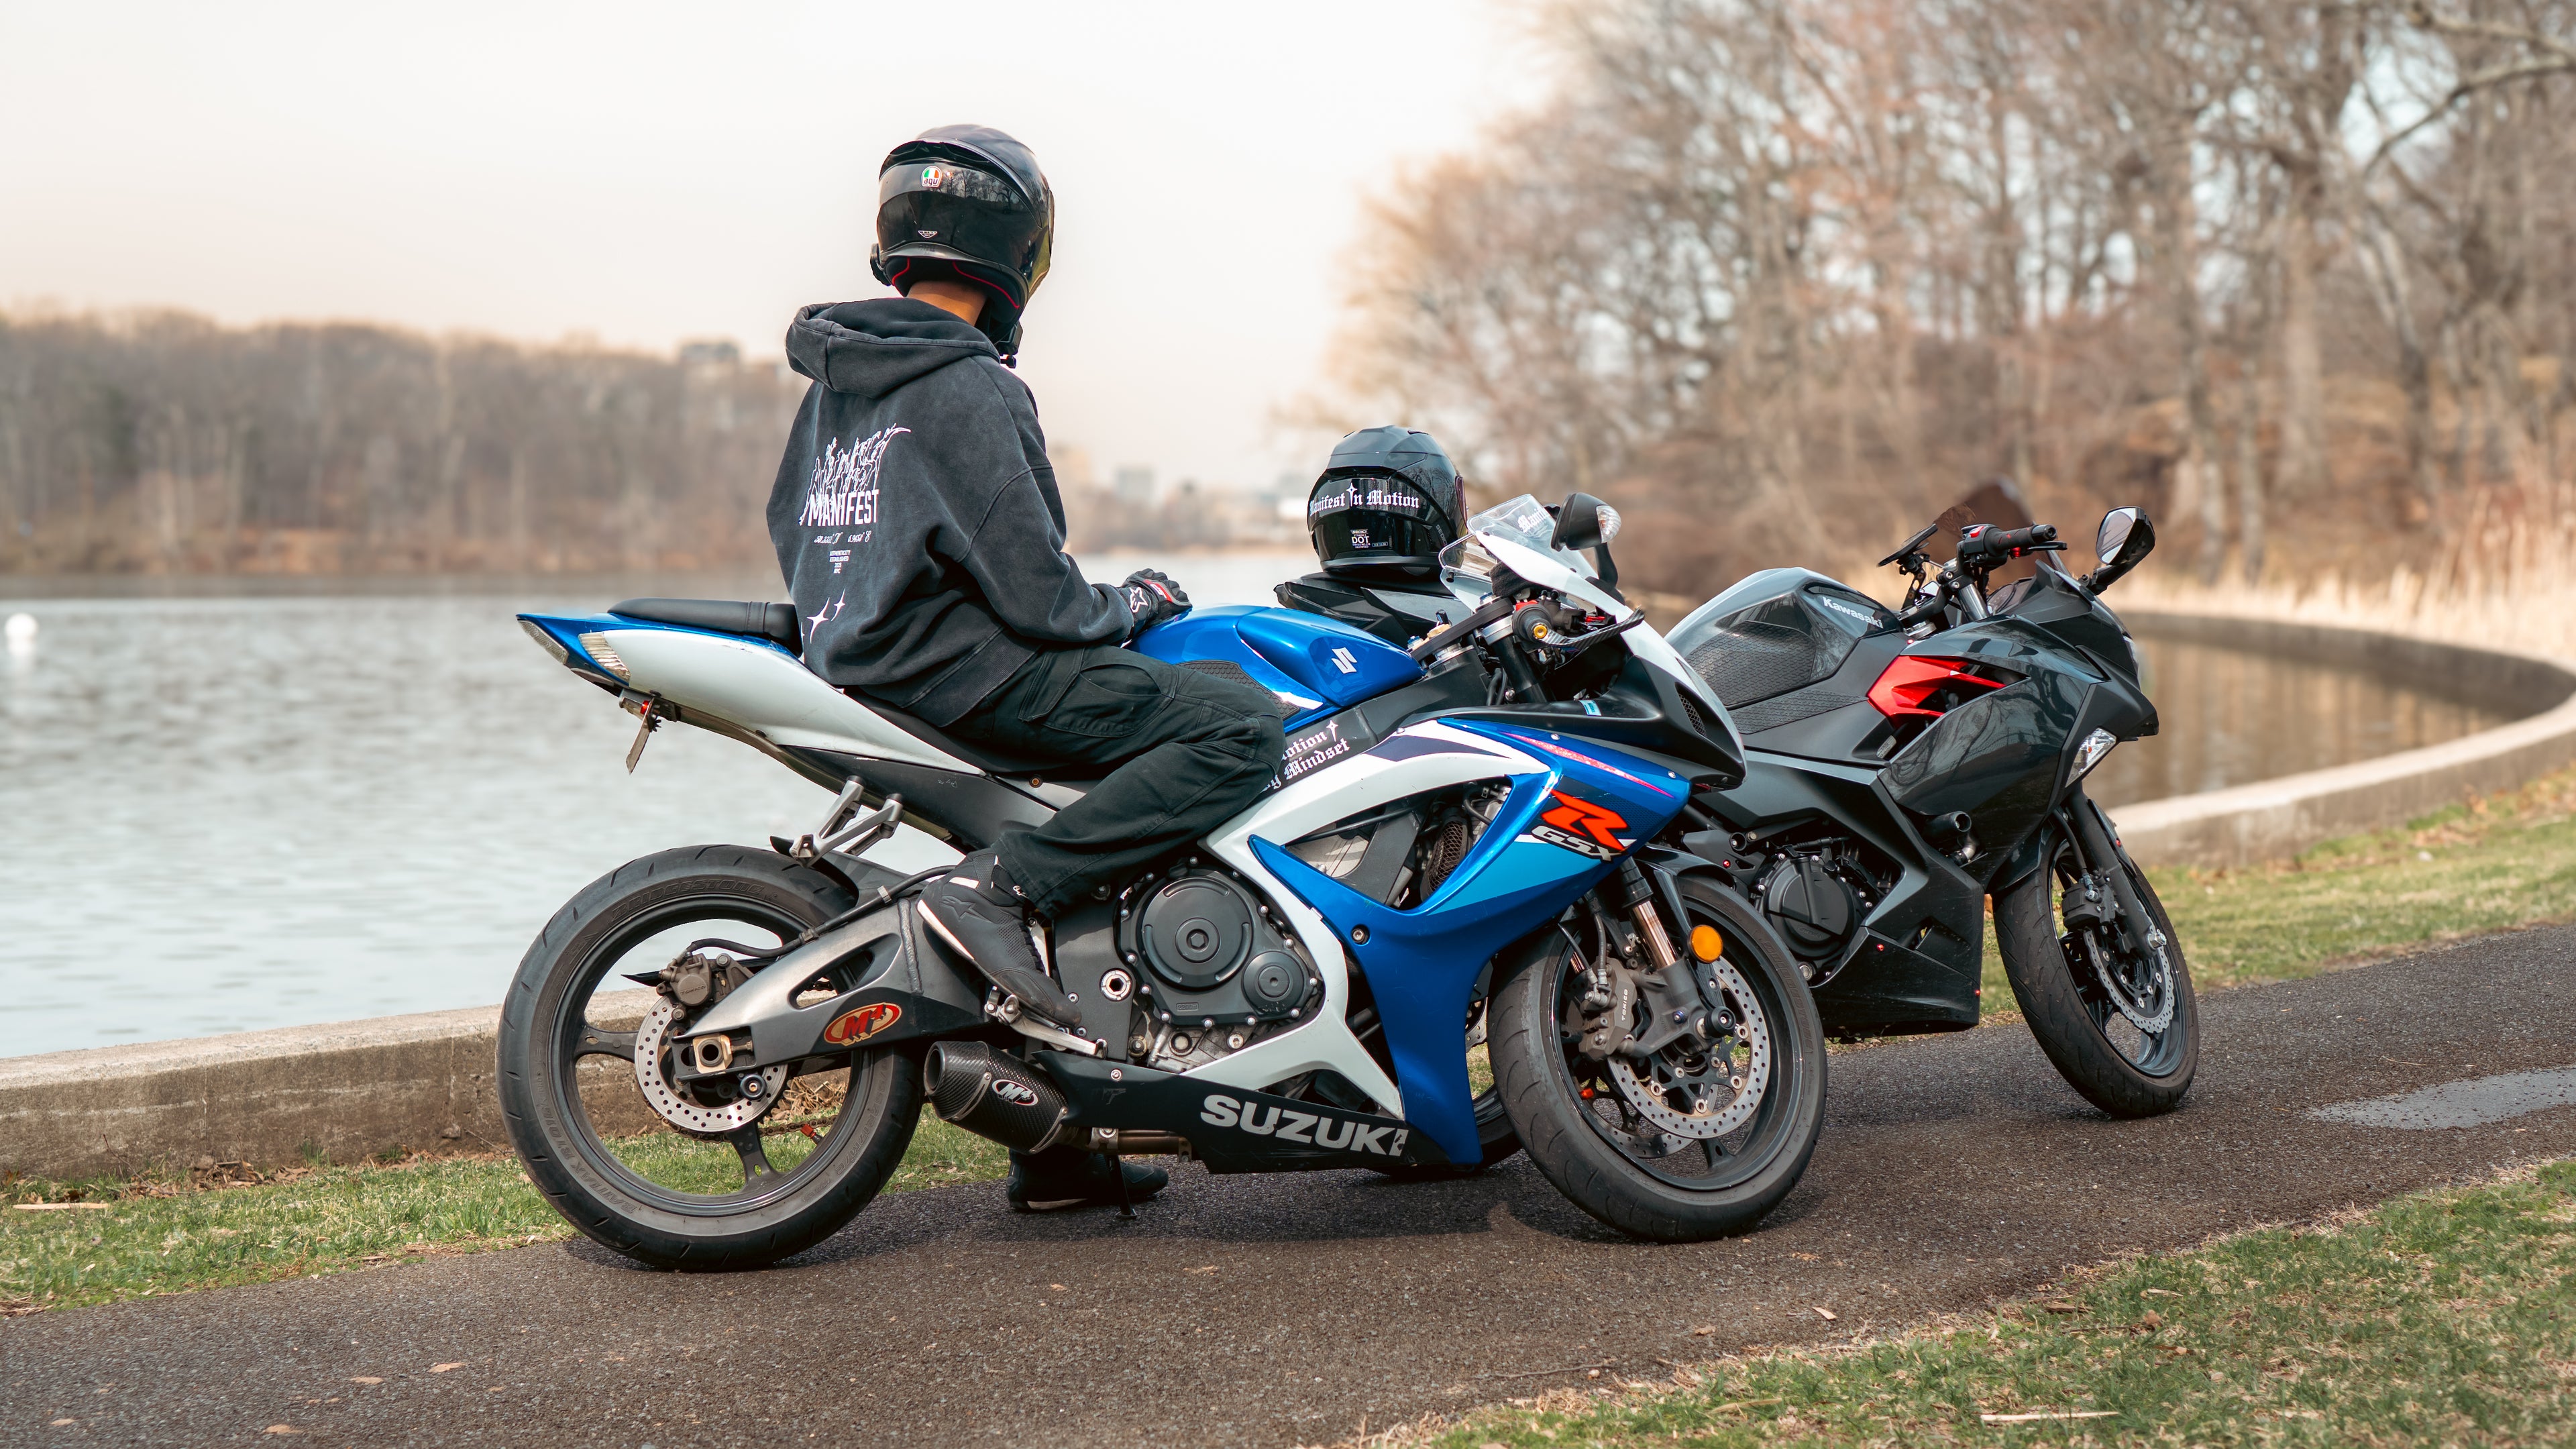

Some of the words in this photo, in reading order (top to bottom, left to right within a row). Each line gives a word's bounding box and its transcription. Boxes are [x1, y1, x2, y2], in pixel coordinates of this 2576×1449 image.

[924, 178, 938, 186] agv
[808, 489, 879, 526] MANIFEST
[1366, 489, 1420, 509] Motion
[1352, 536, 1369, 544] DOT
[1436, 524, 1448, 546] SEDIC
[1823, 596, 1884, 629] Kawasaki
[1284, 737, 1350, 780] Mindset
[1541, 789, 1629, 851] R
[1532, 825, 1622, 862] GSX
[610, 878, 765, 922] BRIDGESTONE
[839, 1004, 888, 1046] M4
[997, 1082, 1034, 1105] M4
[1200, 1094, 1409, 1157] SUZUKI
[570, 1161, 639, 1214] BATTLAX
